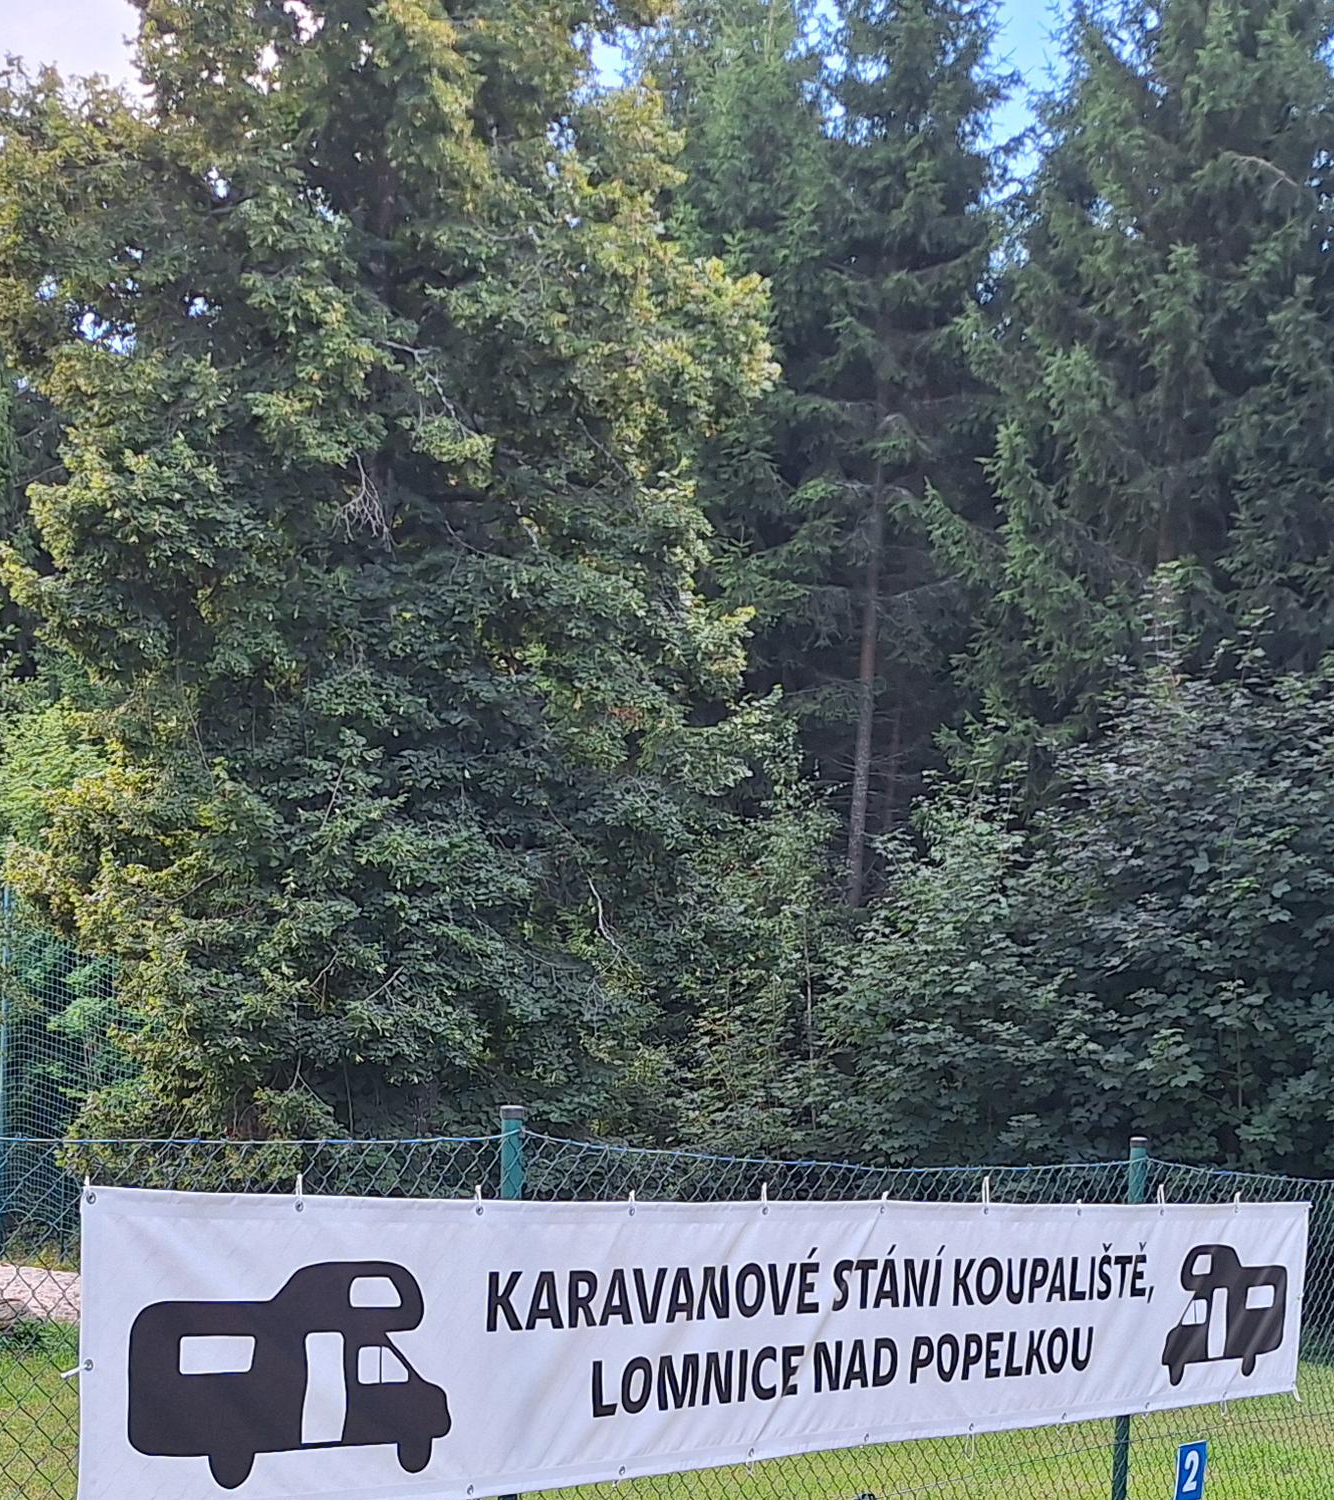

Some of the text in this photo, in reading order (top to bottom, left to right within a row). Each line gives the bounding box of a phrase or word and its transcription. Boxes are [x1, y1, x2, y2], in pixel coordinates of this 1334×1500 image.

[486, 1241, 1155, 1332] KARAVANOVÉ STÁNÍ KOUPALIŠTĚ,
[591, 1326, 1094, 1418] LOMNICE NAD POPELKOU
[1182, 1450, 1200, 1493] 2
